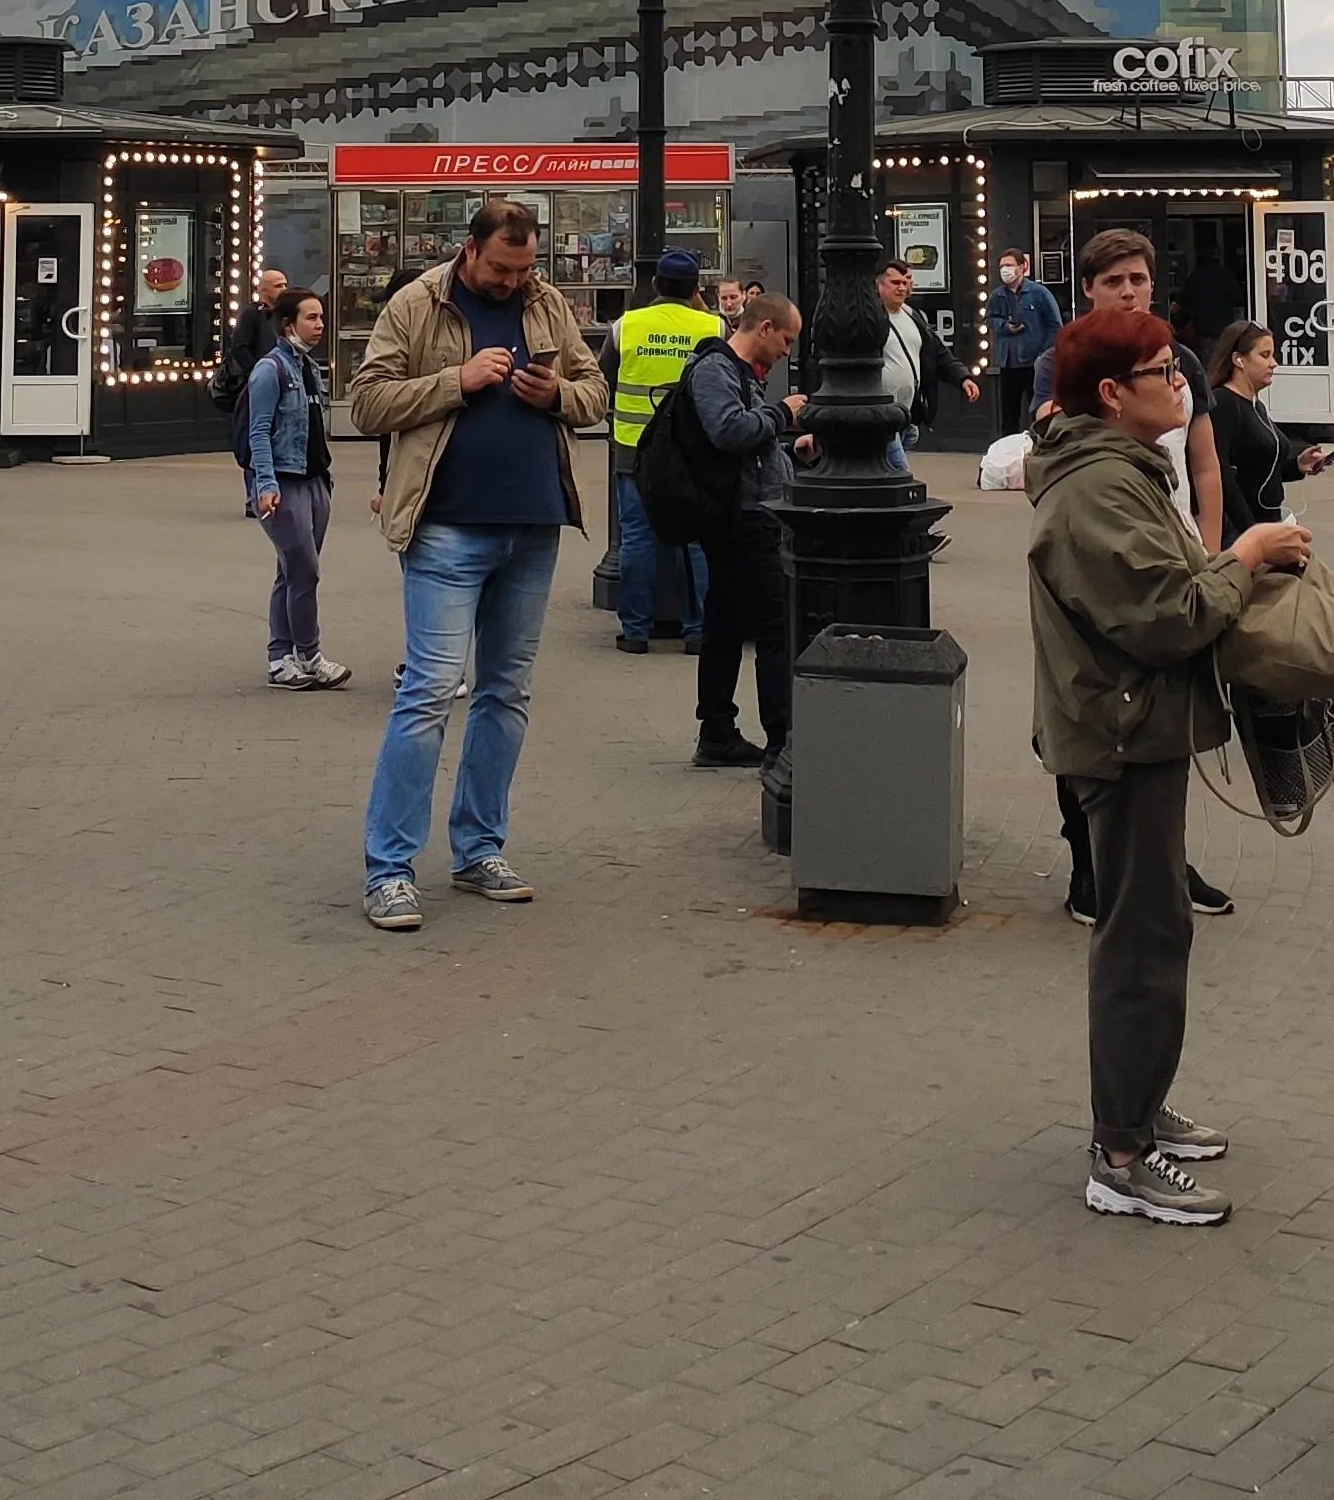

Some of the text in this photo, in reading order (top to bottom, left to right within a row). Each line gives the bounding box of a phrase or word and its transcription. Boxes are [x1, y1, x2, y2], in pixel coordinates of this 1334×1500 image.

[1113, 37, 1242, 78] cofix
[1093, 79, 1128, 92] fresh
[1184, 79, 1219, 92] fixed
[433, 155, 589, 173] ПРЕСС ЛАЙН
[647, 333, 692, 346] ООО ФПК
[1280, 339, 1315, 366] fix
